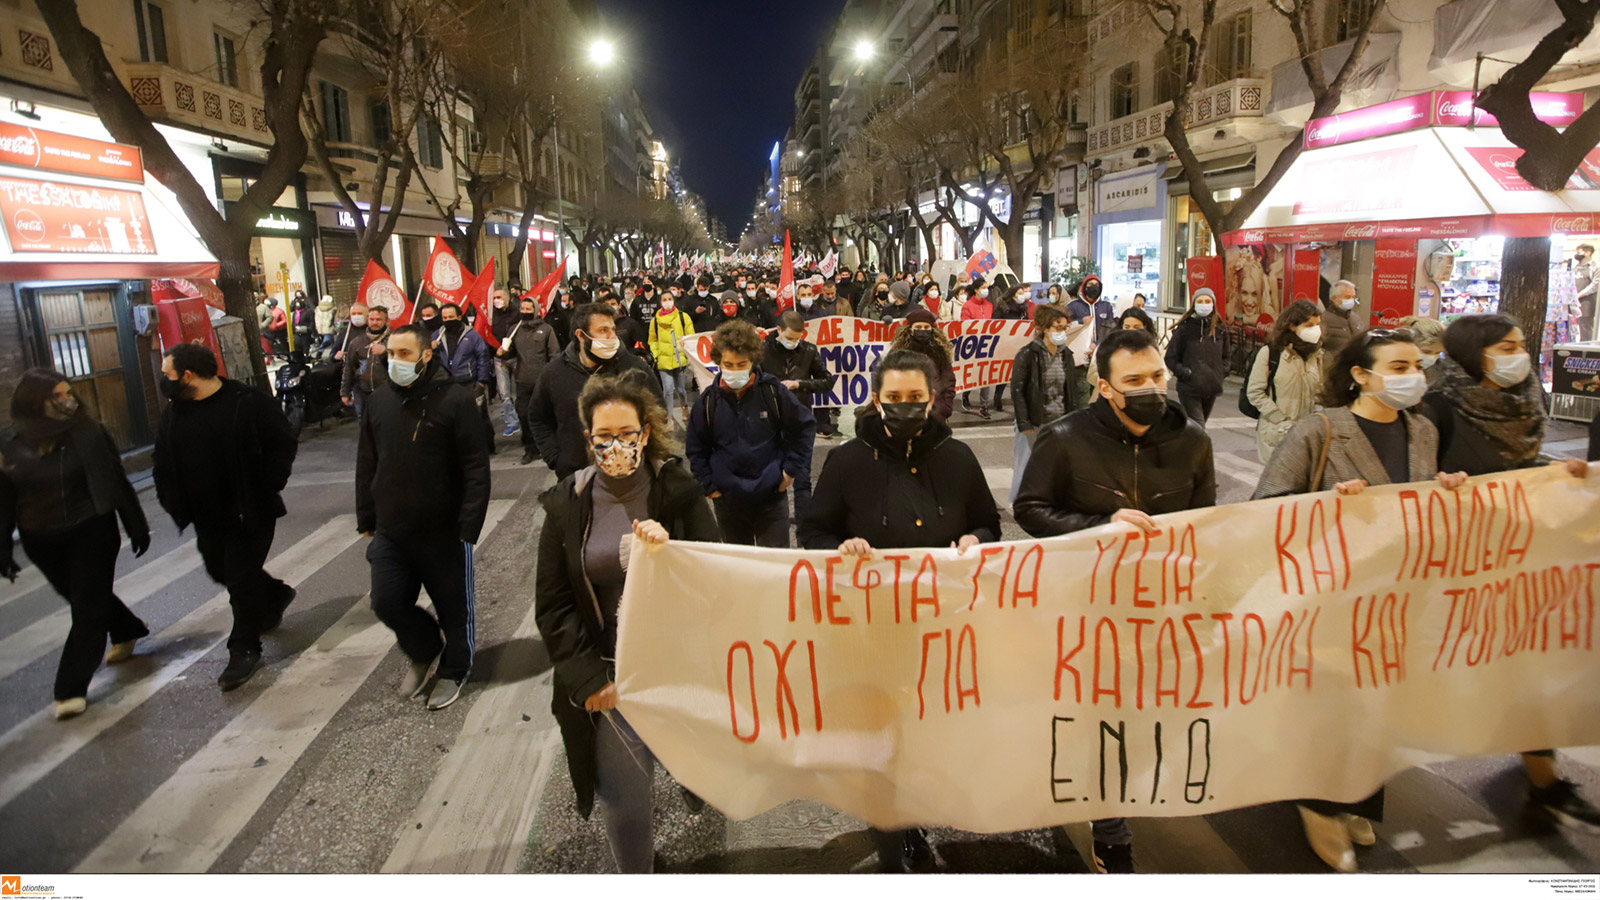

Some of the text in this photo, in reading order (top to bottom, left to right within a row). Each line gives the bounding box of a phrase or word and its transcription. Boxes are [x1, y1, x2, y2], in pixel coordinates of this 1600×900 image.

[1106, 186, 1148, 200] ASCARIDIS
[1345, 225, 1376, 237] Coca-Cola
[1553, 217, 1590, 232] Coca-Cola
[816, 318, 844, 345] ΔΕ
[969, 544, 1045, 611] ΓΙΑ
[1275, 498, 1352, 595] ΚΑΙ
[1396, 479, 1533, 582] ΠΑΙΔΕΙΑ
[726, 639, 823, 743] ΟΧΙ
[917, 624, 981, 720] ΓΙΑ
[1053, 606, 1320, 710] ΚΑΤΑΣΤΟΛΗ
[1353, 591, 1410, 689] ΚΑΙ
[1050, 715, 1215, 804] Ε.Ν.Ι.Θ.
